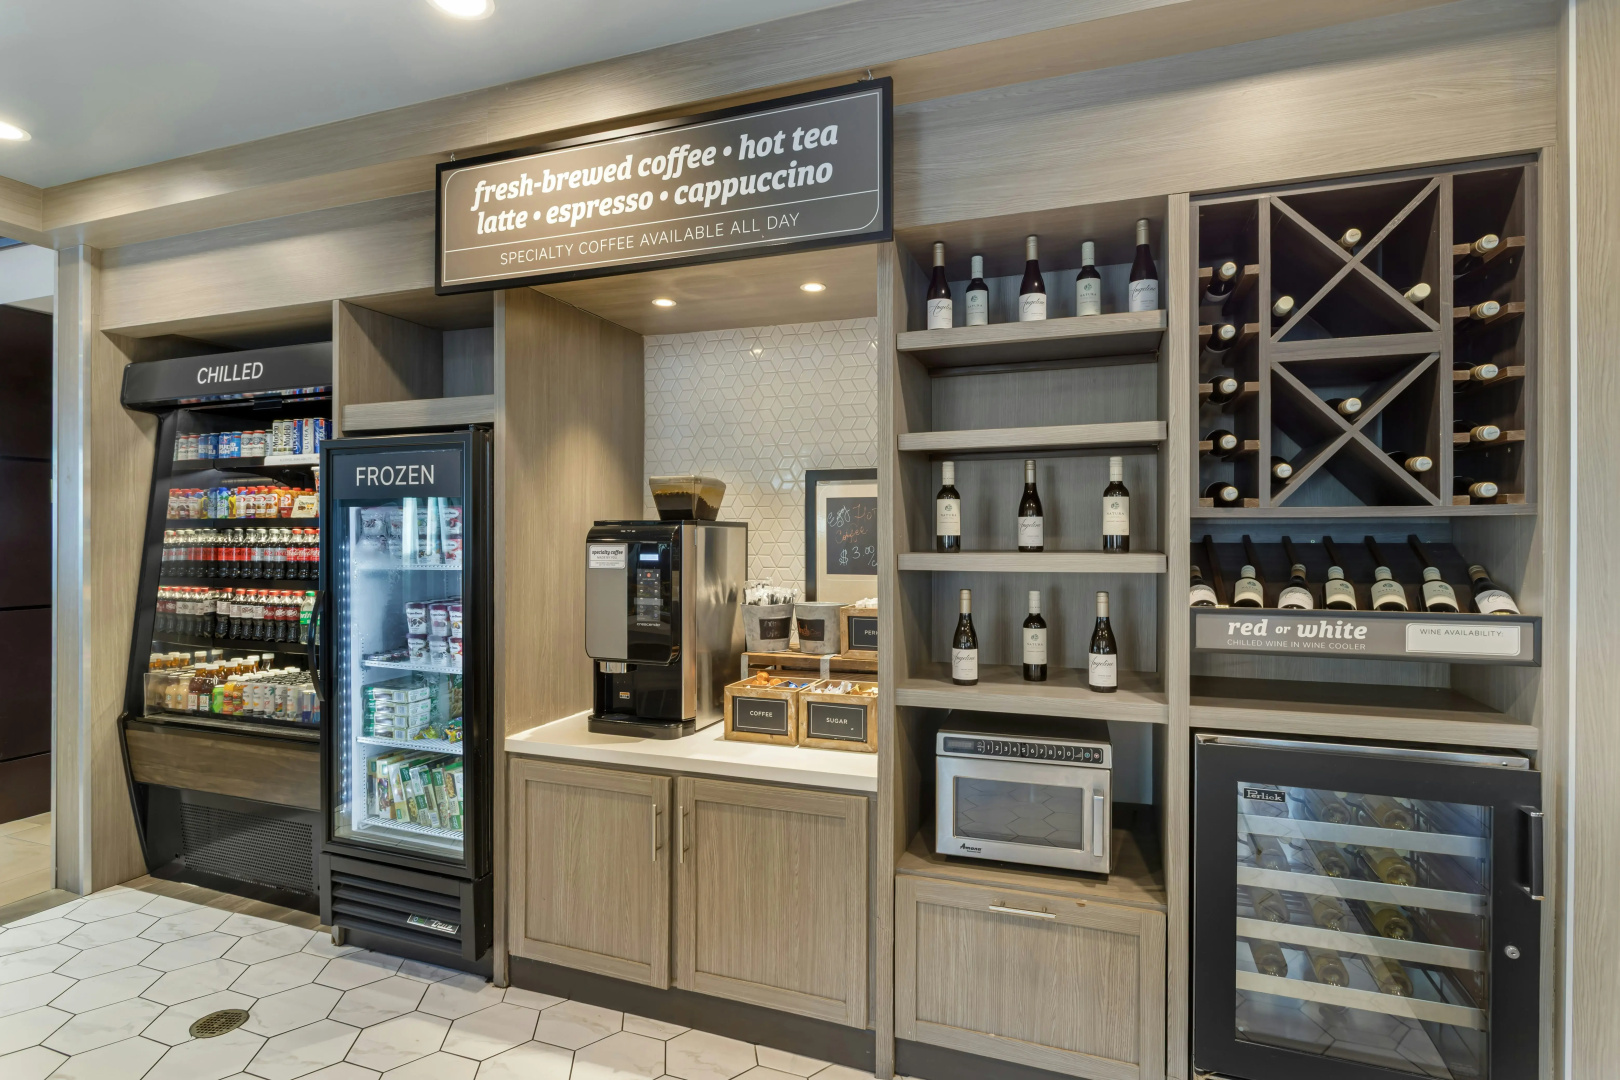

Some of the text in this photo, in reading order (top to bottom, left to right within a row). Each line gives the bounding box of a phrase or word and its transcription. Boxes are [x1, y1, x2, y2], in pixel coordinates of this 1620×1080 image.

[470, 124, 838, 211] fresh-brewed coffee hot tea
[477, 160, 833, 235] latte espresso cappuccino
[500, 212, 800, 266] SPECIALTY COFFEE AVAILABLE ALL DAY
[197, 362, 263, 385] CHILLED
[356, 464, 435, 486] FROZEN
[1228, 619, 1368, 640] red or white
[1420, 628, 1441, 636] WINE
[1227, 639, 1263, 647] CHILLED
[1265, 640, 1288, 648] WINE
[1302, 641, 1326, 649] WINE
[1329, 642, 1366, 650] COOLER
[749, 710, 773, 718] COFFEE
[826, 717, 848, 725] SUGAR
[1246, 790, 1283, 801] Perlick
